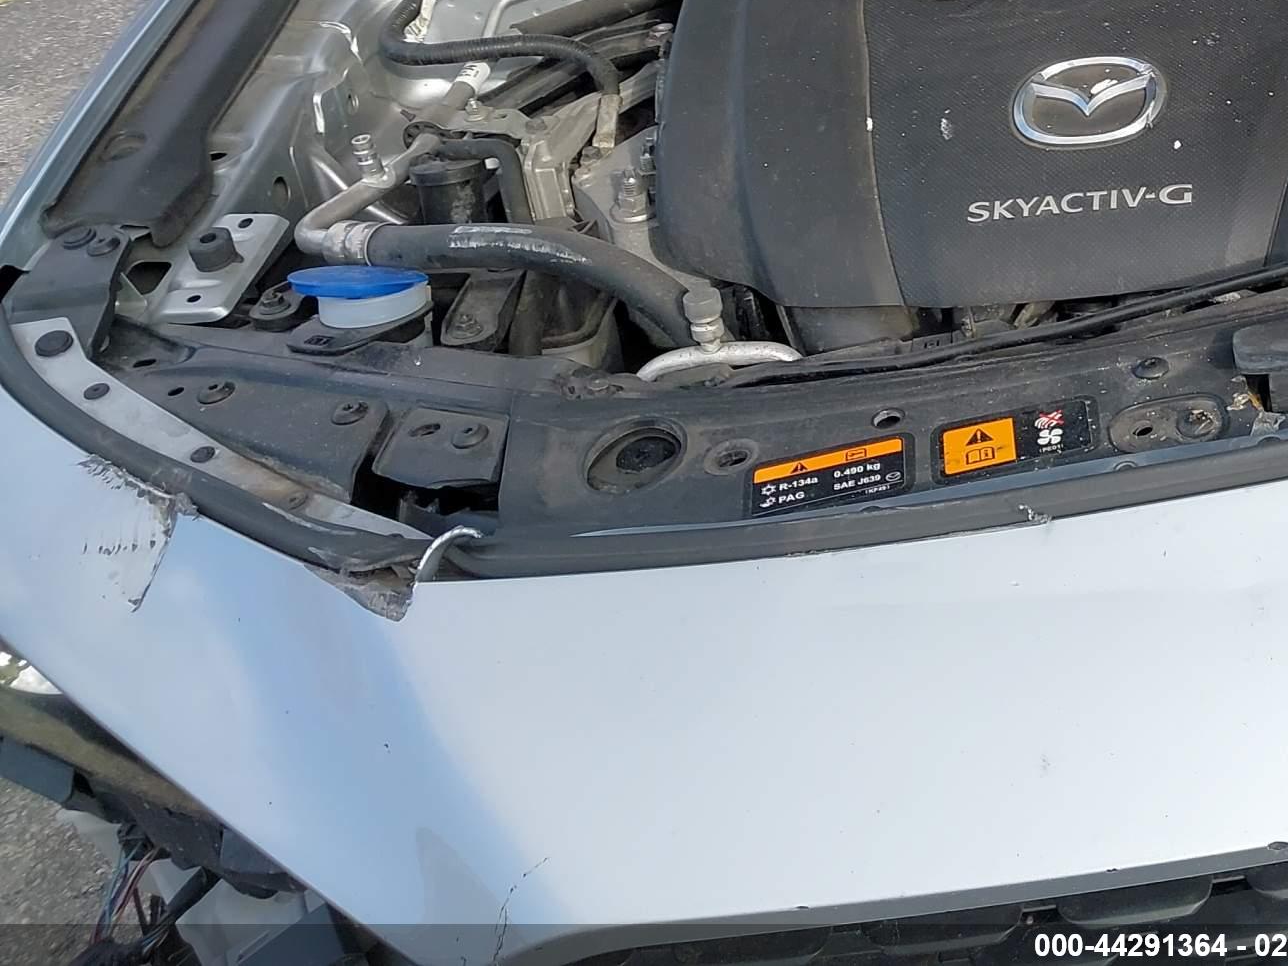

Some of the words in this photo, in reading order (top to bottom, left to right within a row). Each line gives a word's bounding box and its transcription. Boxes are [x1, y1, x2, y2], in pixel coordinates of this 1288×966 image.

[967, 184, 1193, 223] SKYACTIV-G
[866, 461, 881, 472] kg
[778, 476, 818, 492] R-134a
[833, 479, 855, 491] SAE
[857, 474, 881, 486] J639
[778, 491, 805, 504] PAG
